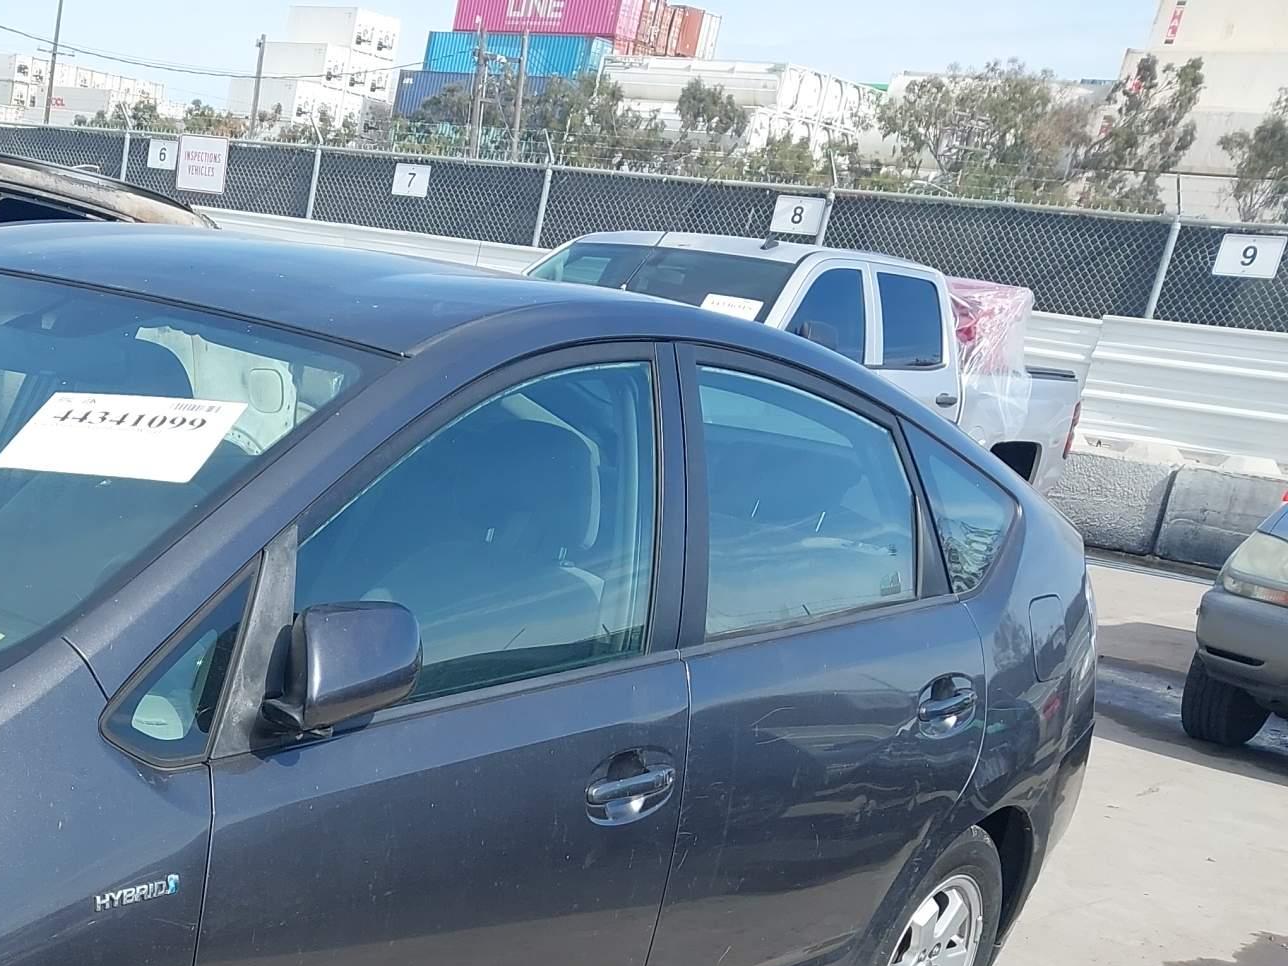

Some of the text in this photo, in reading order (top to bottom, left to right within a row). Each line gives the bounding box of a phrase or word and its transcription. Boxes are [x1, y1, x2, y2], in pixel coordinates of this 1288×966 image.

[158, 147, 168, 162] 6
[184, 151, 223, 163] INSPECTIONS
[188, 165, 215, 176] VEHICLES
[407, 172, 417, 188] 7
[790, 205, 804, 225] 8
[1240, 245, 1258, 267] 9
[52, 409, 208, 431] 44341099
[94, 880, 168, 912] HYBRID
